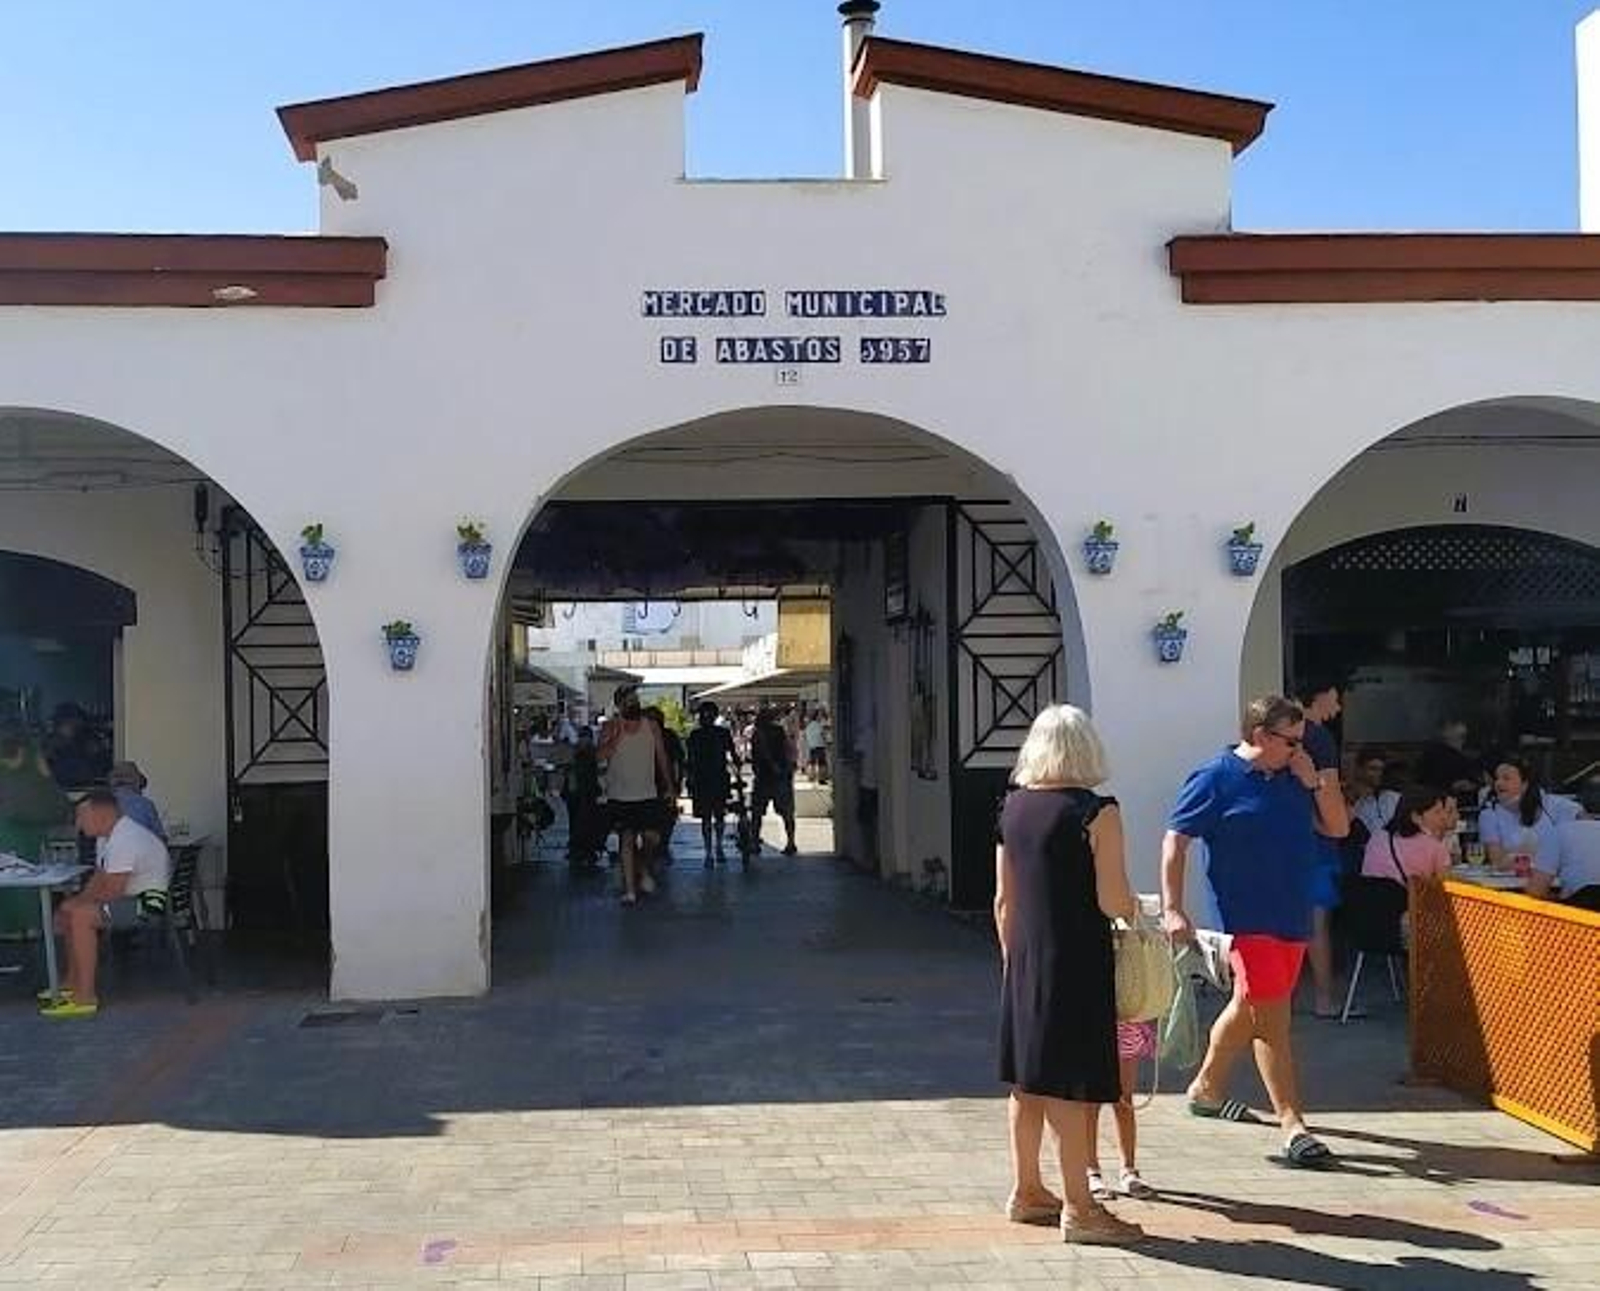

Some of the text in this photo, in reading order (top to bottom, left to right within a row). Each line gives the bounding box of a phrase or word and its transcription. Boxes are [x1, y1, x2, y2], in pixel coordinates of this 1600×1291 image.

[642, 292, 945, 315] MERCADO MUNICIPAL
[662, 338, 695, 361] DE
[717, 338, 840, 361] ABASTOS
[779, 369, 798, 383] 12
